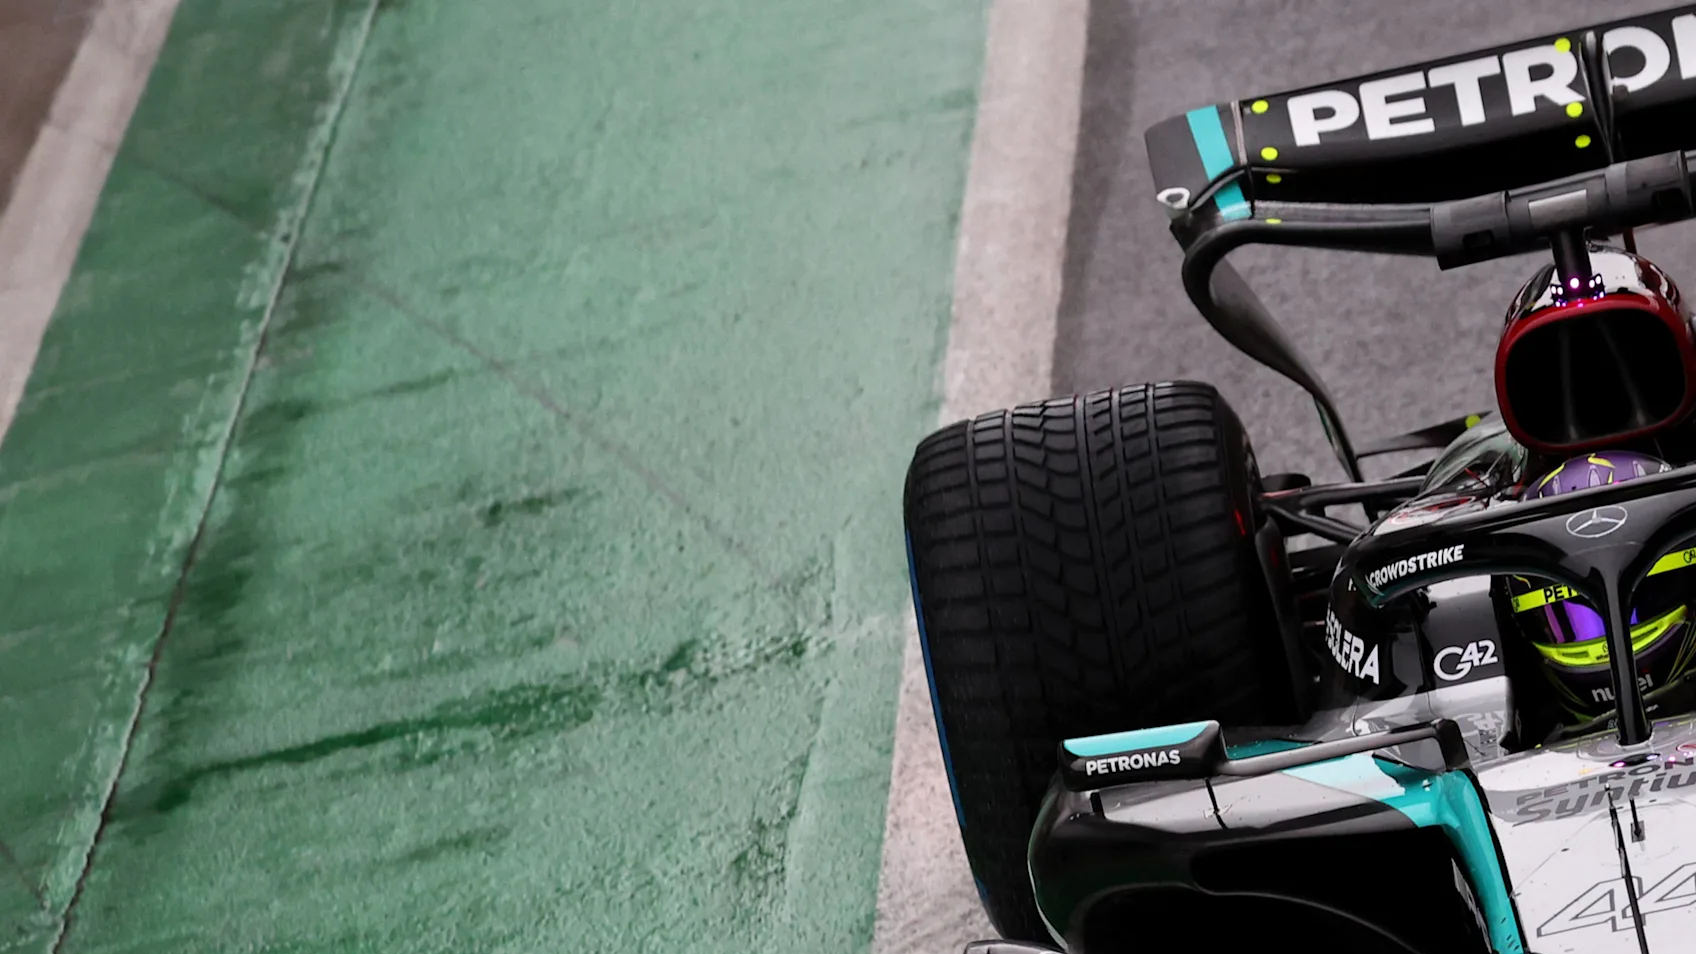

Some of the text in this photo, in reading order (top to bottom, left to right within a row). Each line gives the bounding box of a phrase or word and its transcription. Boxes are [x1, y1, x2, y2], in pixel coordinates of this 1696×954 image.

[1369, 544, 1465, 589] CROWDSTRIKE
[1327, 610, 1380, 686] SOLERA
[1433, 639, 1498, 681] G42
[1085, 749, 1181, 776] PETRONAS
